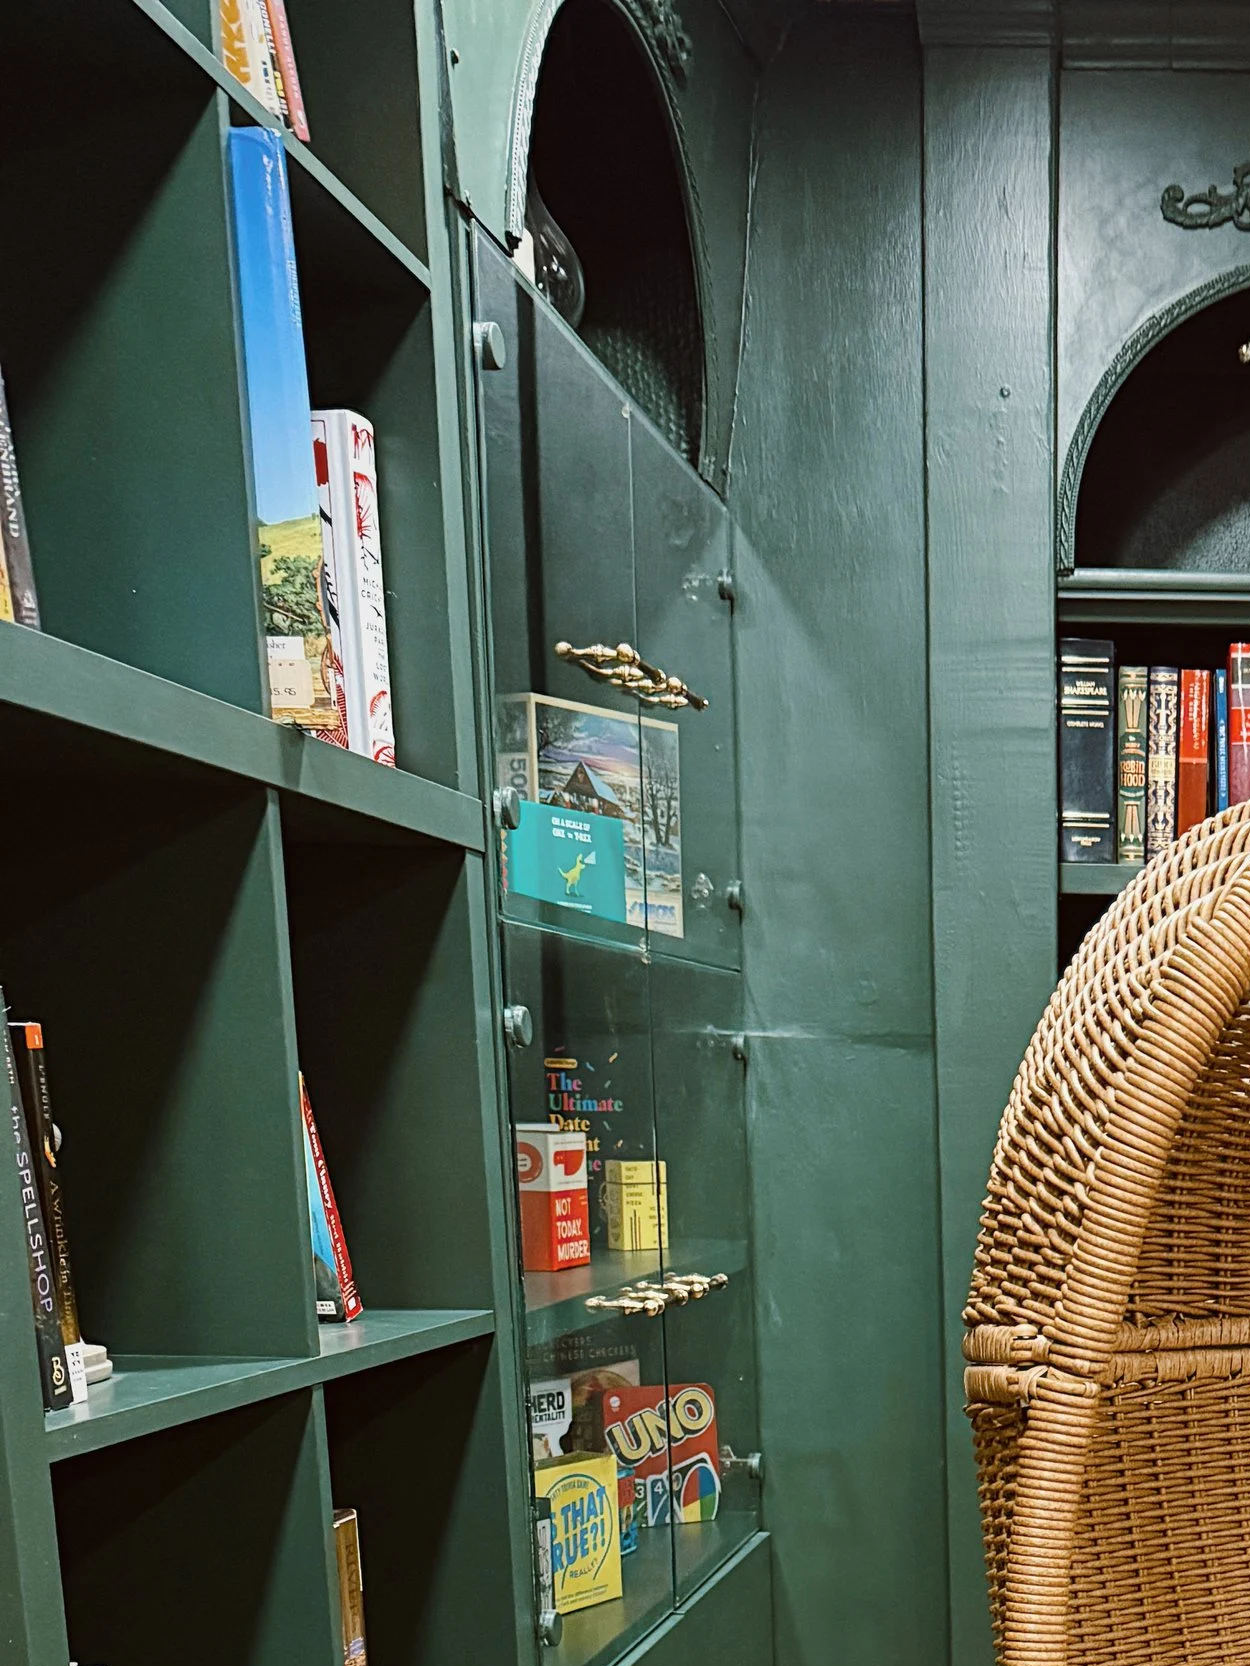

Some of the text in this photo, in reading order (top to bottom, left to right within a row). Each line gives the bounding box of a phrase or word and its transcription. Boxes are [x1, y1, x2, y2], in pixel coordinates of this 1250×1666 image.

[1121, 774, 1146, 787] HOOD
[546, 1072, 583, 1092] The
[549, 1092, 624, 1112] Ultimate
[549, 1114, 591, 1132] Date
[309, 1121, 320, 1158] Tom
[318, 1158, 332, 1209] Clancy
[49, 1180, 59, 1196] A
[555, 1197, 572, 1217] NOT
[16, 1151, 53, 1313] SPELLSHOP
[51, 1198, 69, 1267] Wrinkle
[556, 1218, 583, 1240] TODAY.
[557, 1240, 590, 1262] MURDER.
[605, 1388, 714, 1466] UNO
[635, 1485, 645, 1499] 3
[653, 1481, 664, 1495] 4
[561, 1485, 606, 1537] THAT
[552, 1518, 606, 1574] RUE?!
